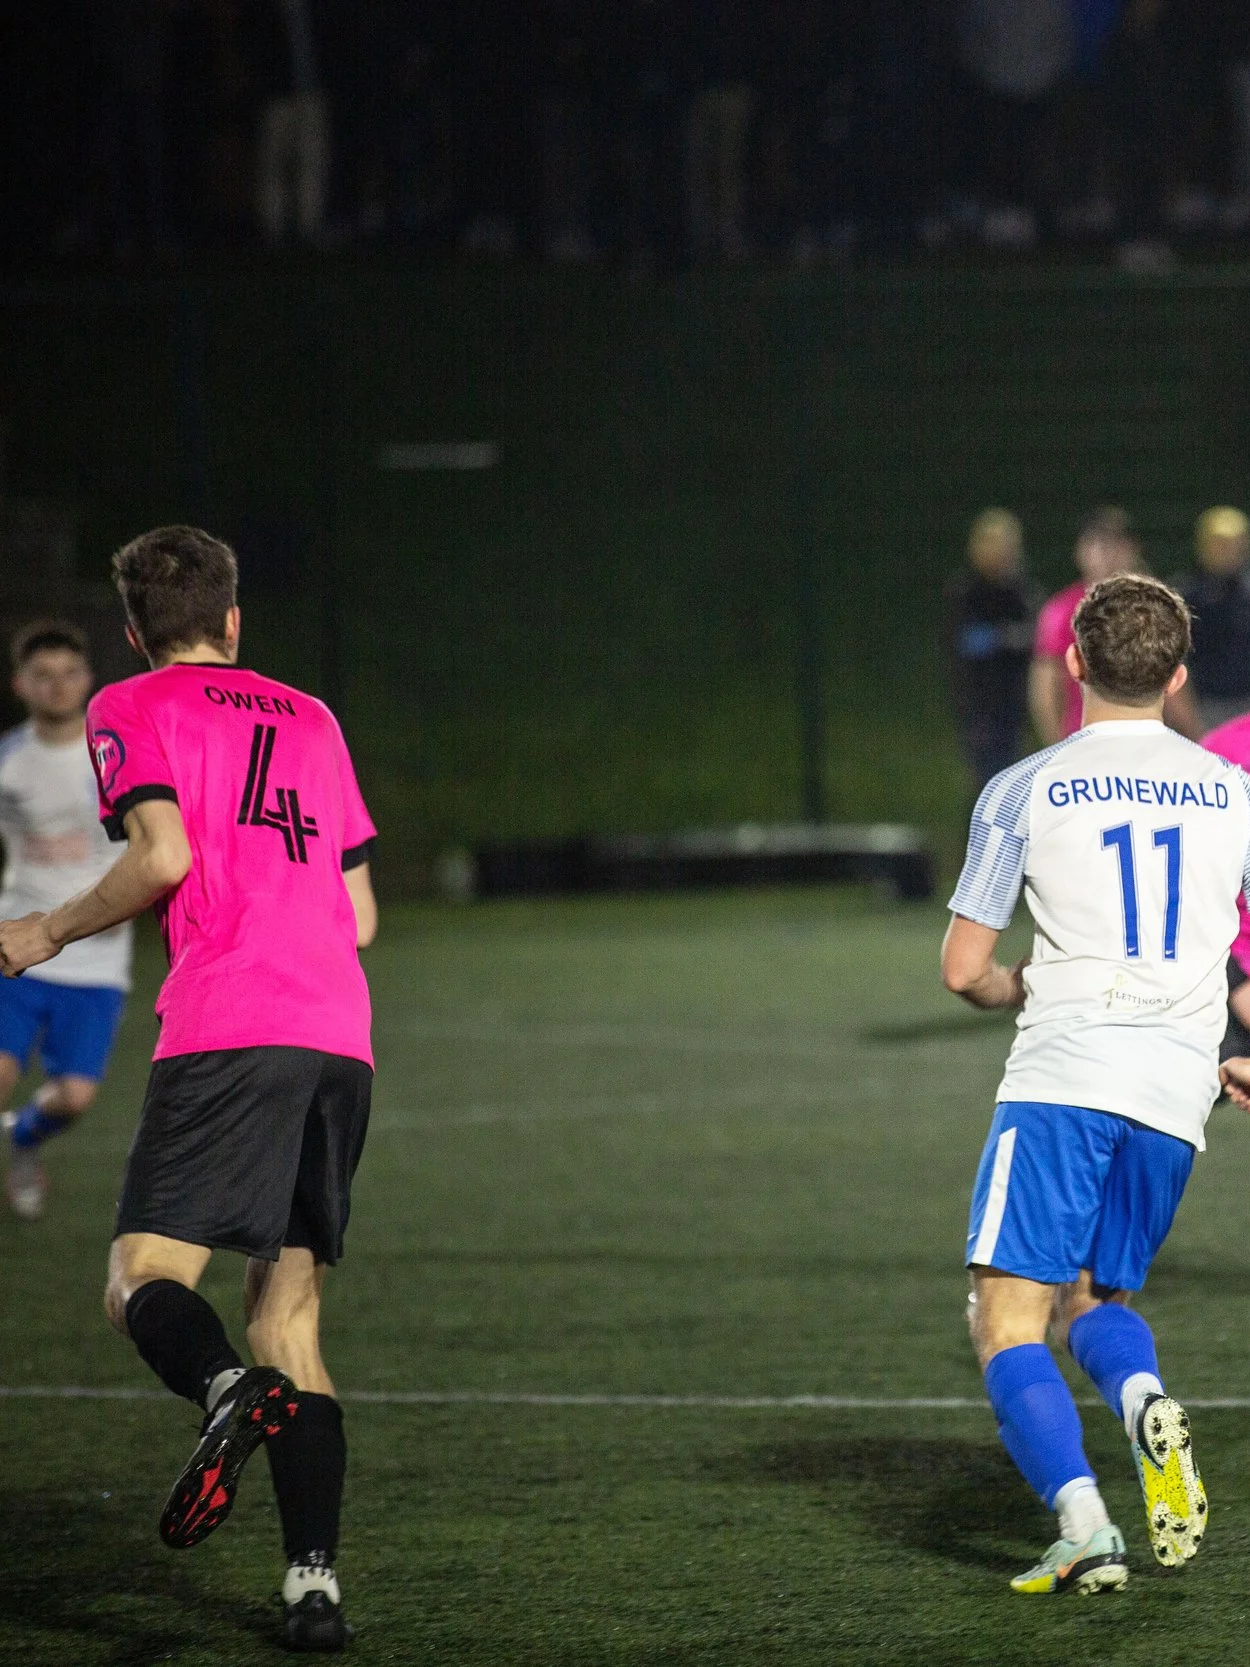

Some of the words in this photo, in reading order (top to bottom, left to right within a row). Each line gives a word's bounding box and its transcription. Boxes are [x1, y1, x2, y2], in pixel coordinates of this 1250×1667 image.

[204, 685, 297, 717] OWEN
[237, 723, 320, 865] 4
[1047, 776, 1229, 810] GRUNEWALD
[1099, 820, 1184, 962] 11
